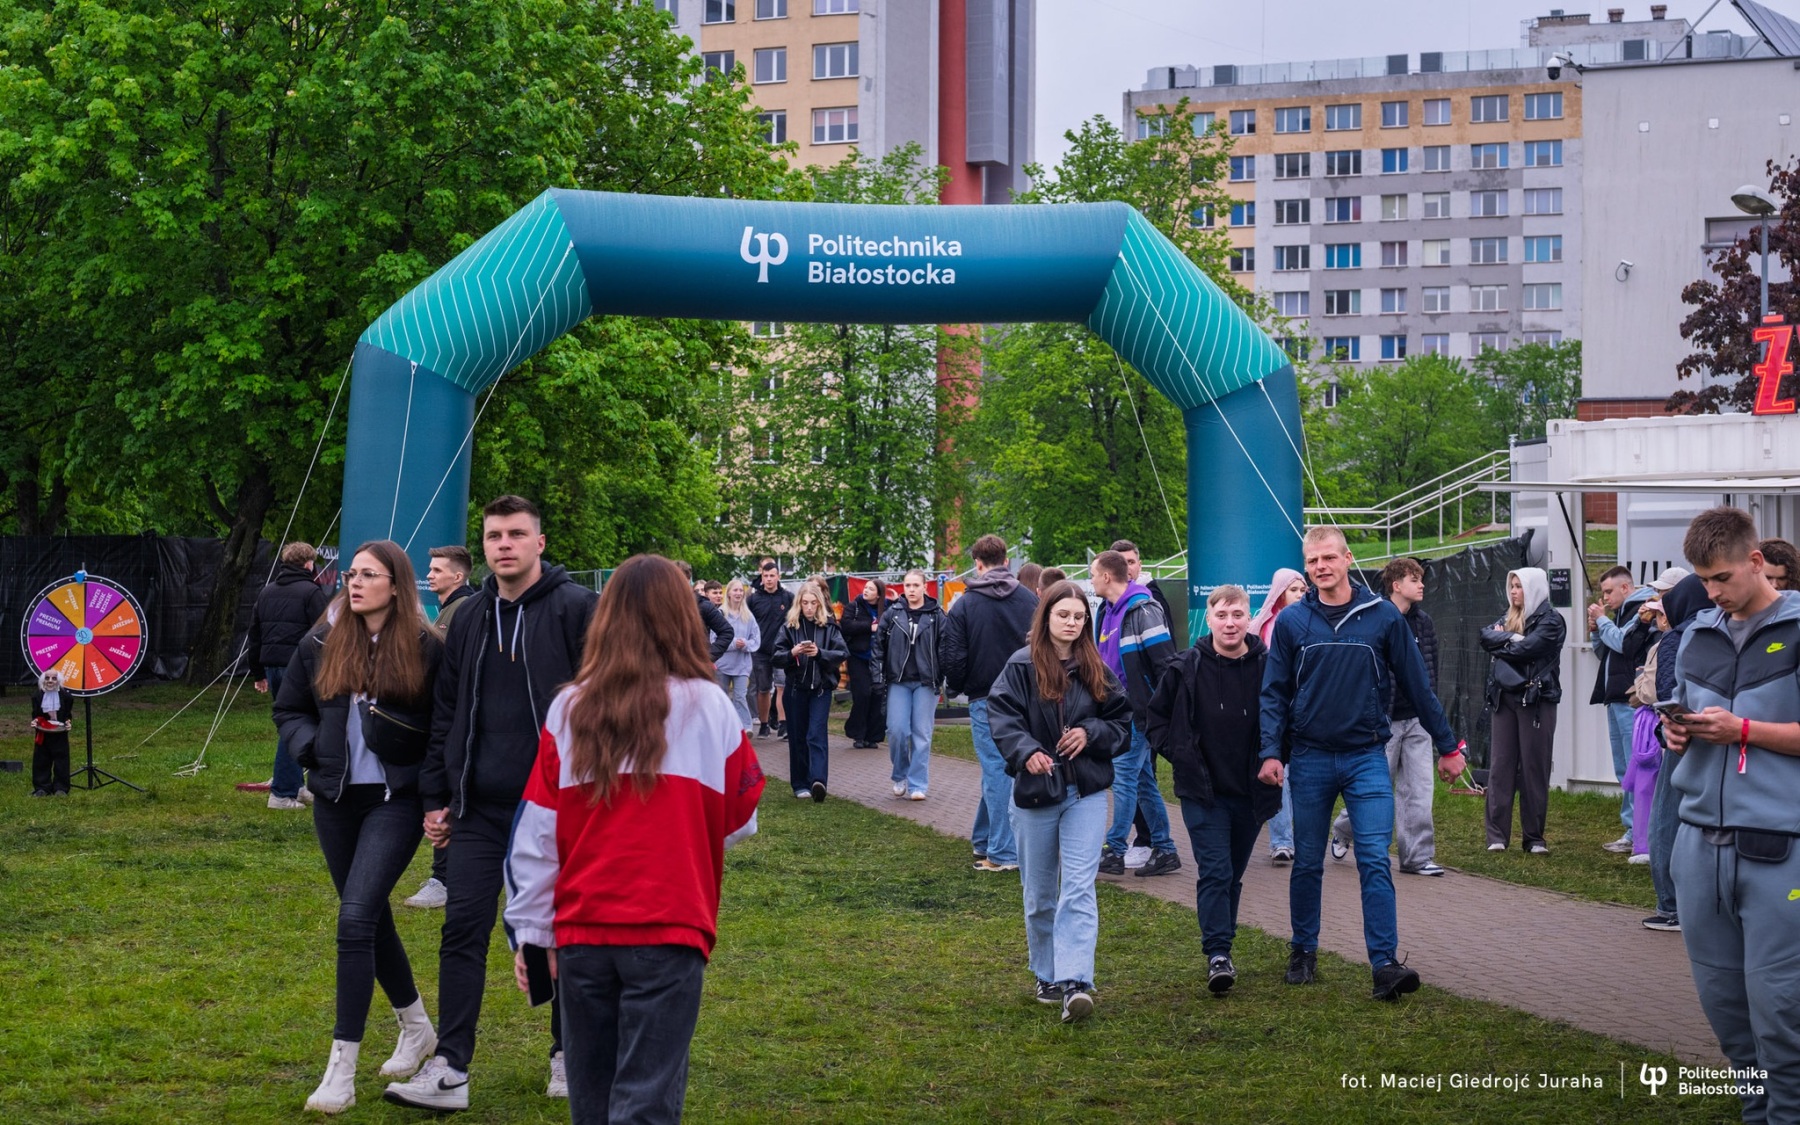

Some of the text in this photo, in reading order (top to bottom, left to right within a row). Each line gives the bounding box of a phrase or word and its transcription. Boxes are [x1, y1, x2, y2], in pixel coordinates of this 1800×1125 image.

[808, 233, 962, 257] Politechnika
[808, 261, 956, 285] Białostocka
[67, 588, 79, 610] PREZENT
[89, 588, 101, 608] SZANSA
[95, 592, 106, 609] JEDNA
[100, 593, 113, 614] JESZCZE
[35, 617, 61, 631] PREMIUM
[39, 612, 62, 625] PREZENT
[112, 617, 134, 630] PREZENT
[35, 643, 58, 656] PREZENT
[109, 646, 132, 659] PREZENT
[71, 668, 80, 679] RAZ
[90, 661, 103, 683] PREZENT
